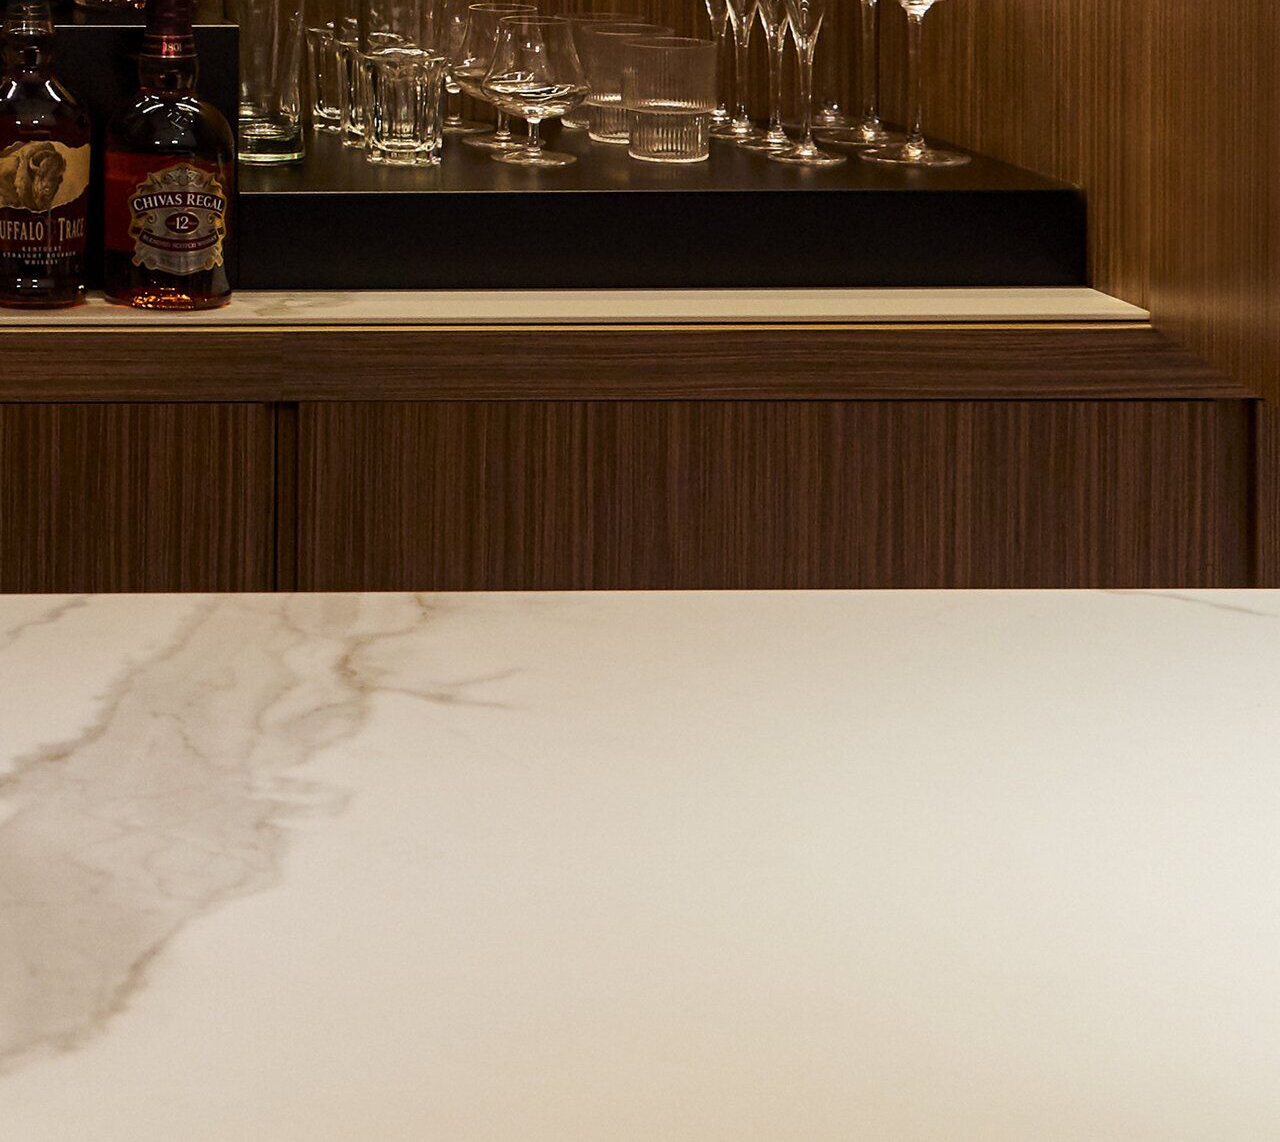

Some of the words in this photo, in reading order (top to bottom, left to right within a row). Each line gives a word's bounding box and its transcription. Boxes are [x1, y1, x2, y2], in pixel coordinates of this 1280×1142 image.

[133, 193, 183, 211] CHIVAS
[186, 193, 223, 211] REGAL
[57, 216, 86, 242] TRACE
[175, 215, 190, 230] 12
